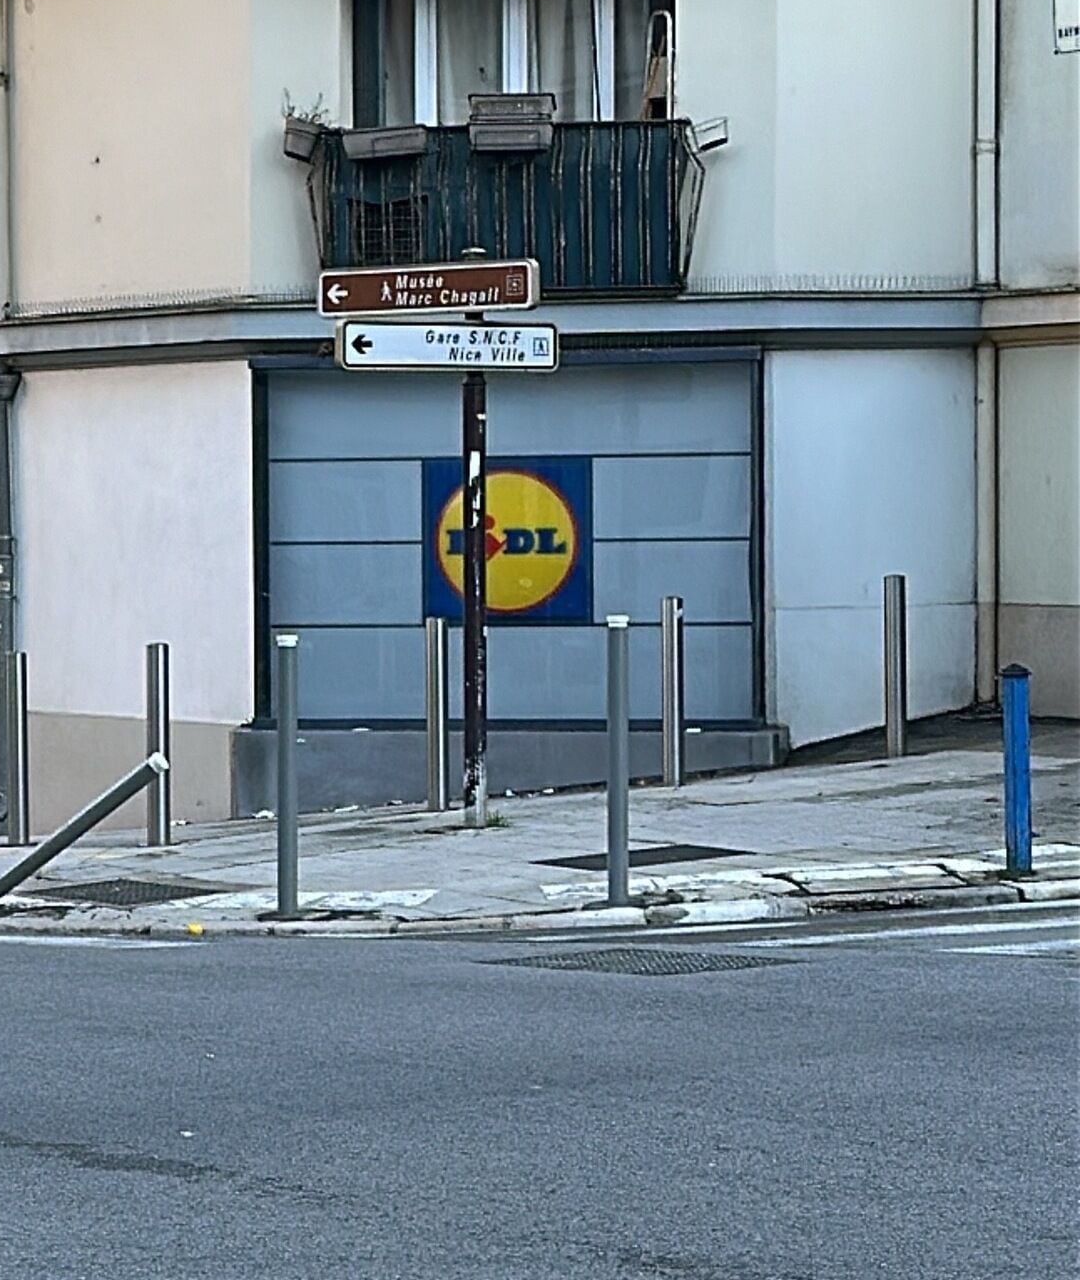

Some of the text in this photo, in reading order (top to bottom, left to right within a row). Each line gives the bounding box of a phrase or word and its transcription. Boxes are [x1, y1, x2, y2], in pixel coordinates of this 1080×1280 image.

[395, 274, 444, 290] Musée
[395, 286, 500, 306] Marc Chagall
[425, 329, 461, 344] Gare
[448, 347, 526, 362] Nice Ville
